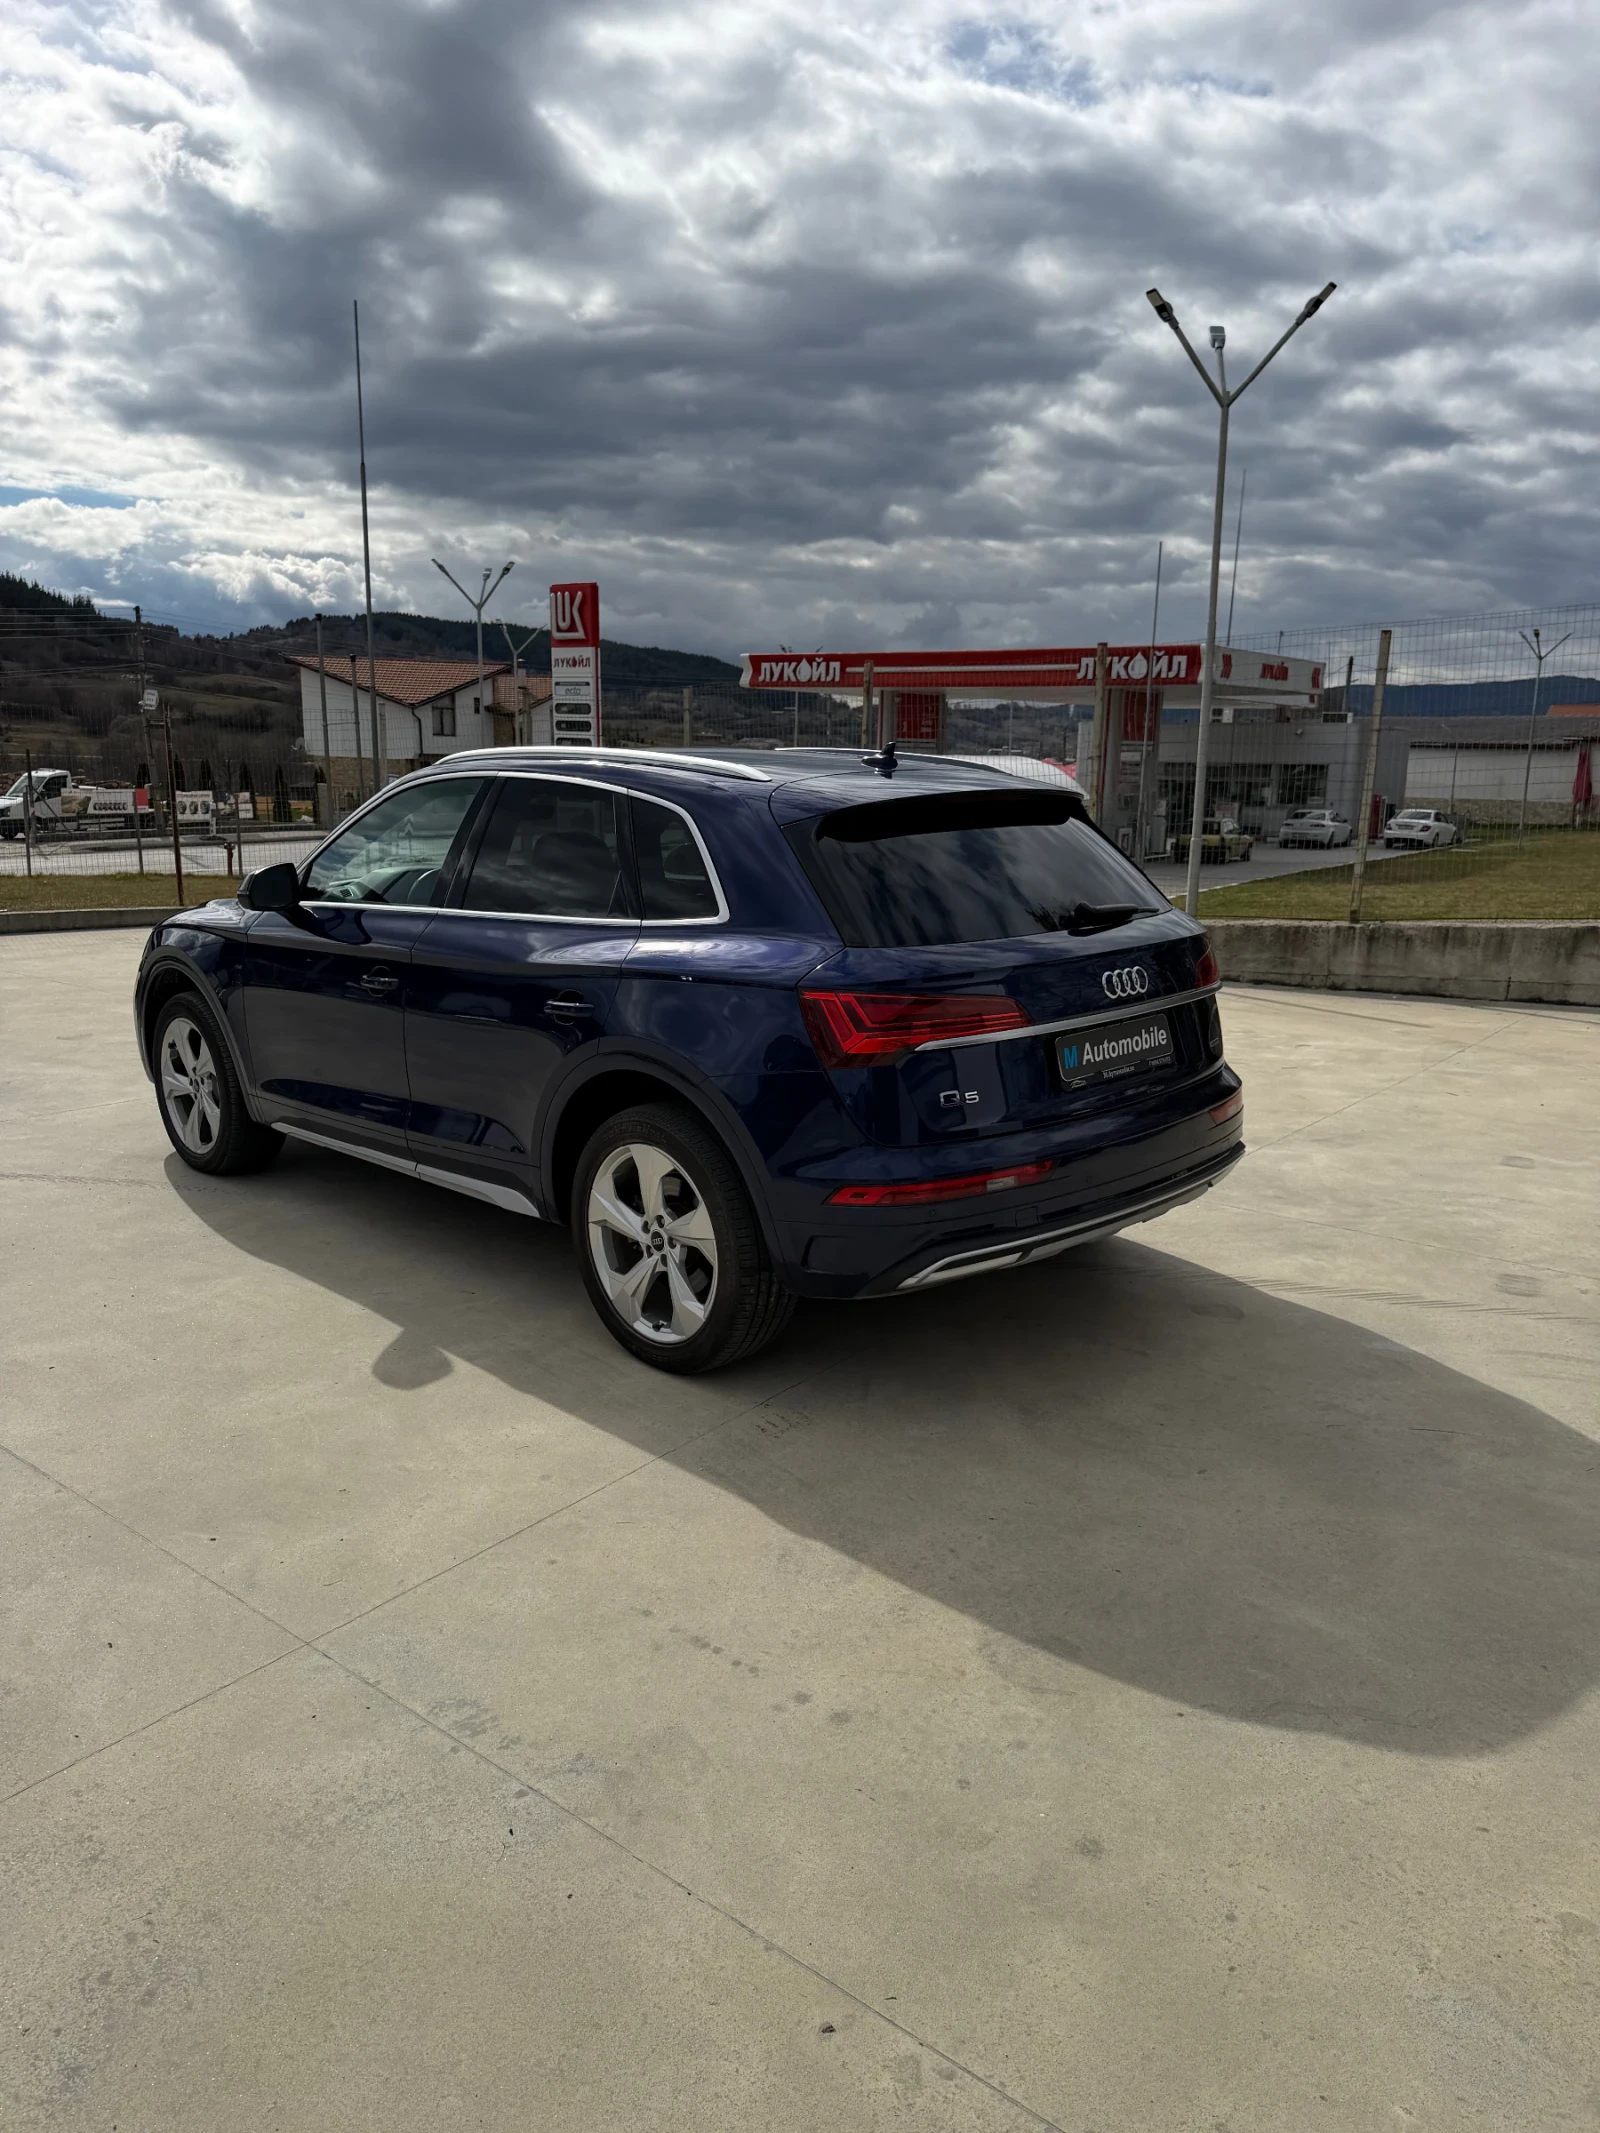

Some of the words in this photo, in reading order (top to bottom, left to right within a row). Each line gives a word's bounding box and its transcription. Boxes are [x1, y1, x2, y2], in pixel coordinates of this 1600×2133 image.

[553, 655, 591, 669] ЛУКОЙЛ
[758, 657, 841, 682] ЛУКОЙЛ
[1063, 1045, 1078, 1069] M
[1082, 1025, 1167, 1065] Automobile
[939, 1090, 980, 1108] Q5
